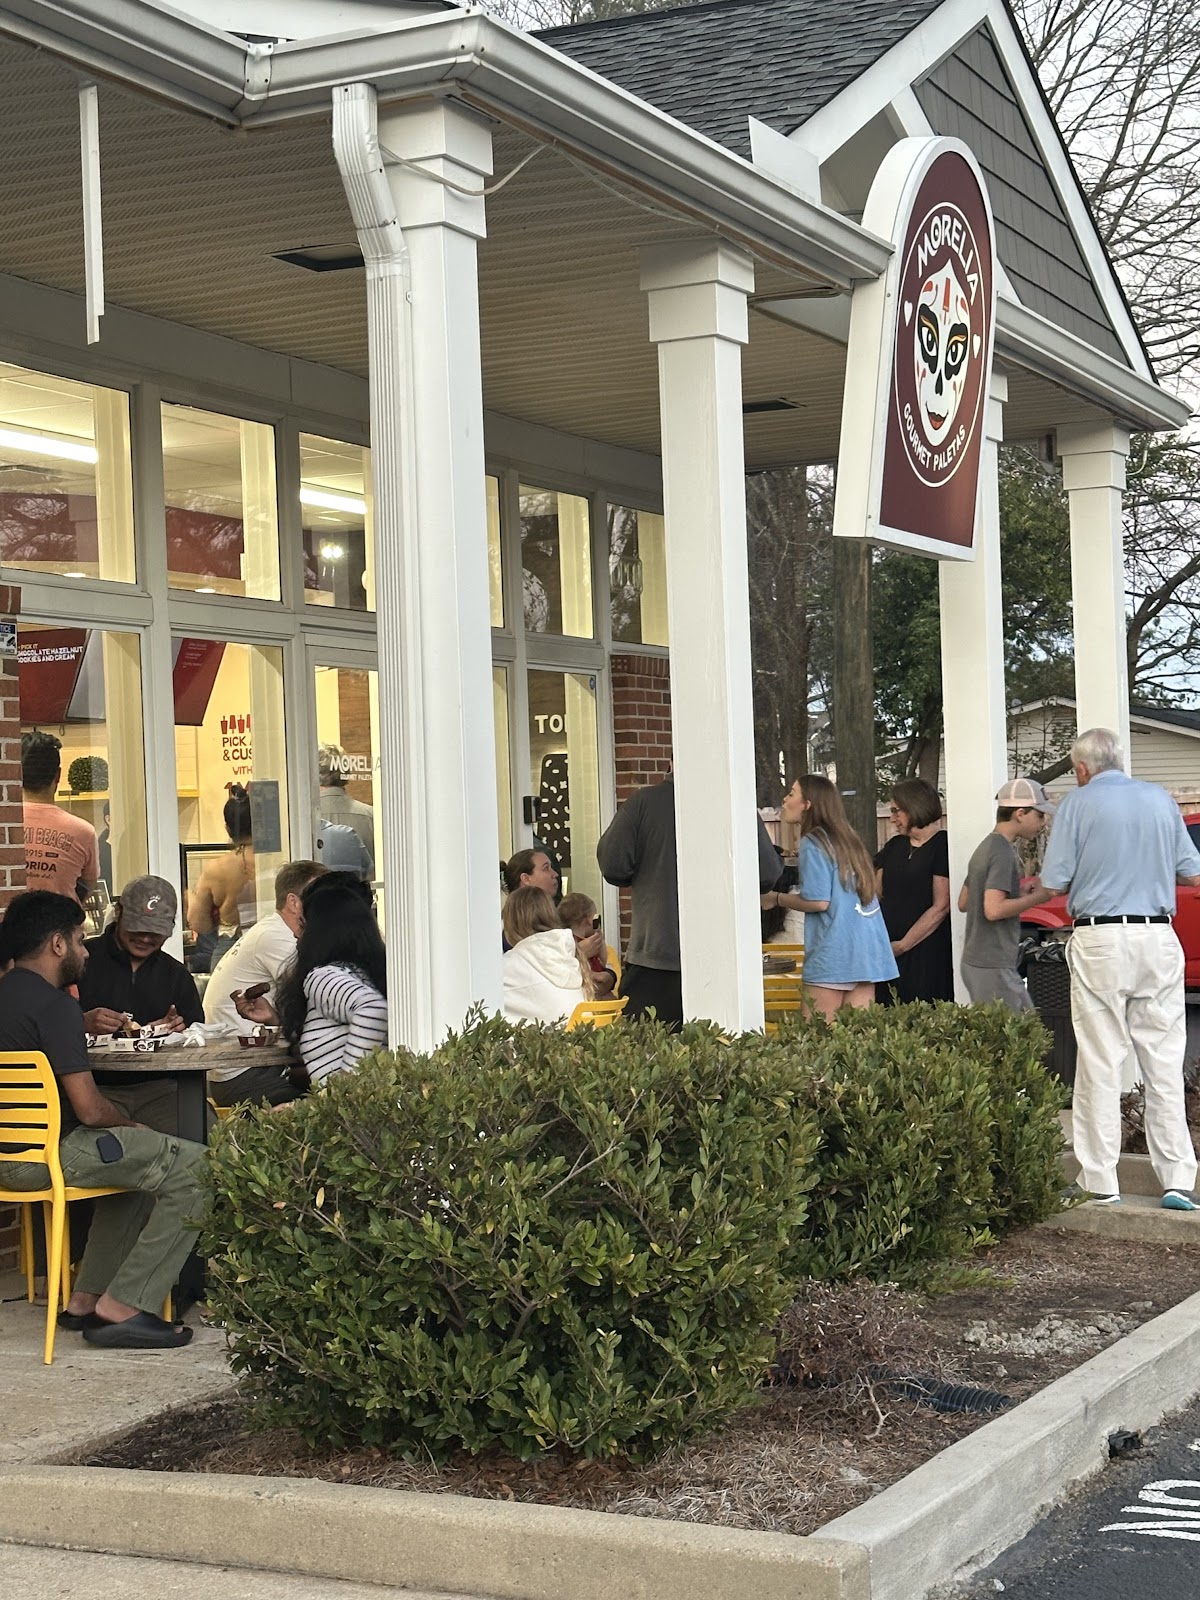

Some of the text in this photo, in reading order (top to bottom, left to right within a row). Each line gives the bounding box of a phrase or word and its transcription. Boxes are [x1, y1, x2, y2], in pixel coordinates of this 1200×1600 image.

[918, 214, 979, 306] MORELIA
[904, 403, 966, 472] GOURMET PALETAS
[51, 646, 84, 655] HAZELNUT
[54, 653, 76, 661] CREAM
[222, 735, 247, 747] PICK
[36, 827, 74, 852] BEACH
